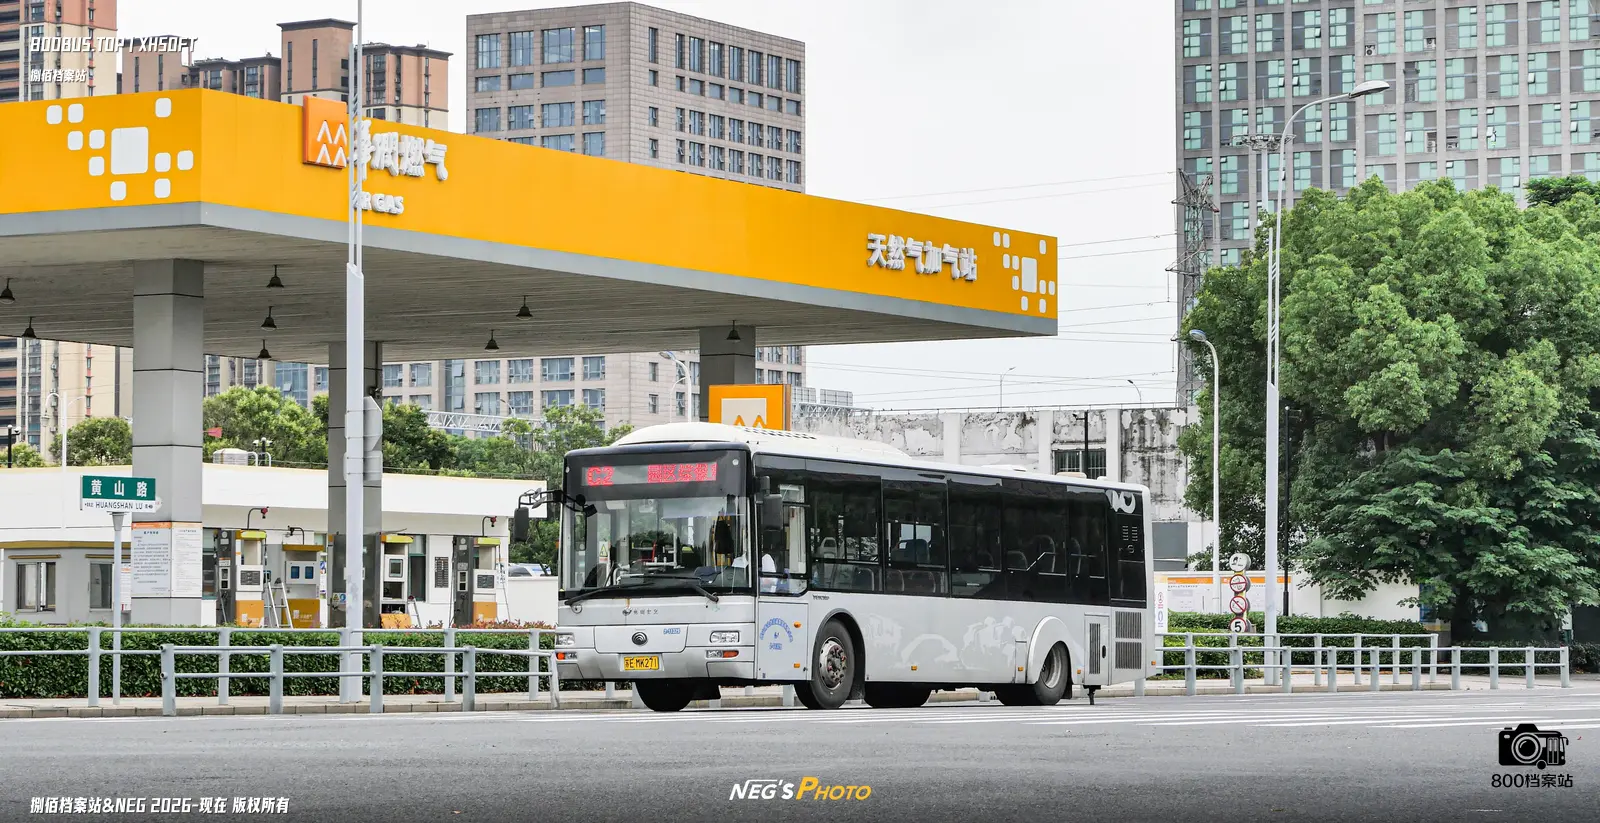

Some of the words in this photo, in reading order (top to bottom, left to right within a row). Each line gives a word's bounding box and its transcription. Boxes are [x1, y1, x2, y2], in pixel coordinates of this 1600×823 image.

[371, 193, 404, 214] GAS
[866, 233, 977, 281] 天然气加气站
[586, 465, 614, 486] C2
[91, 479, 148, 498] 黄山路
[95, 501, 133, 510] HUANGSHAN
[135, 502, 143, 510] LU
[1234, 621, 1242, 633] 5
